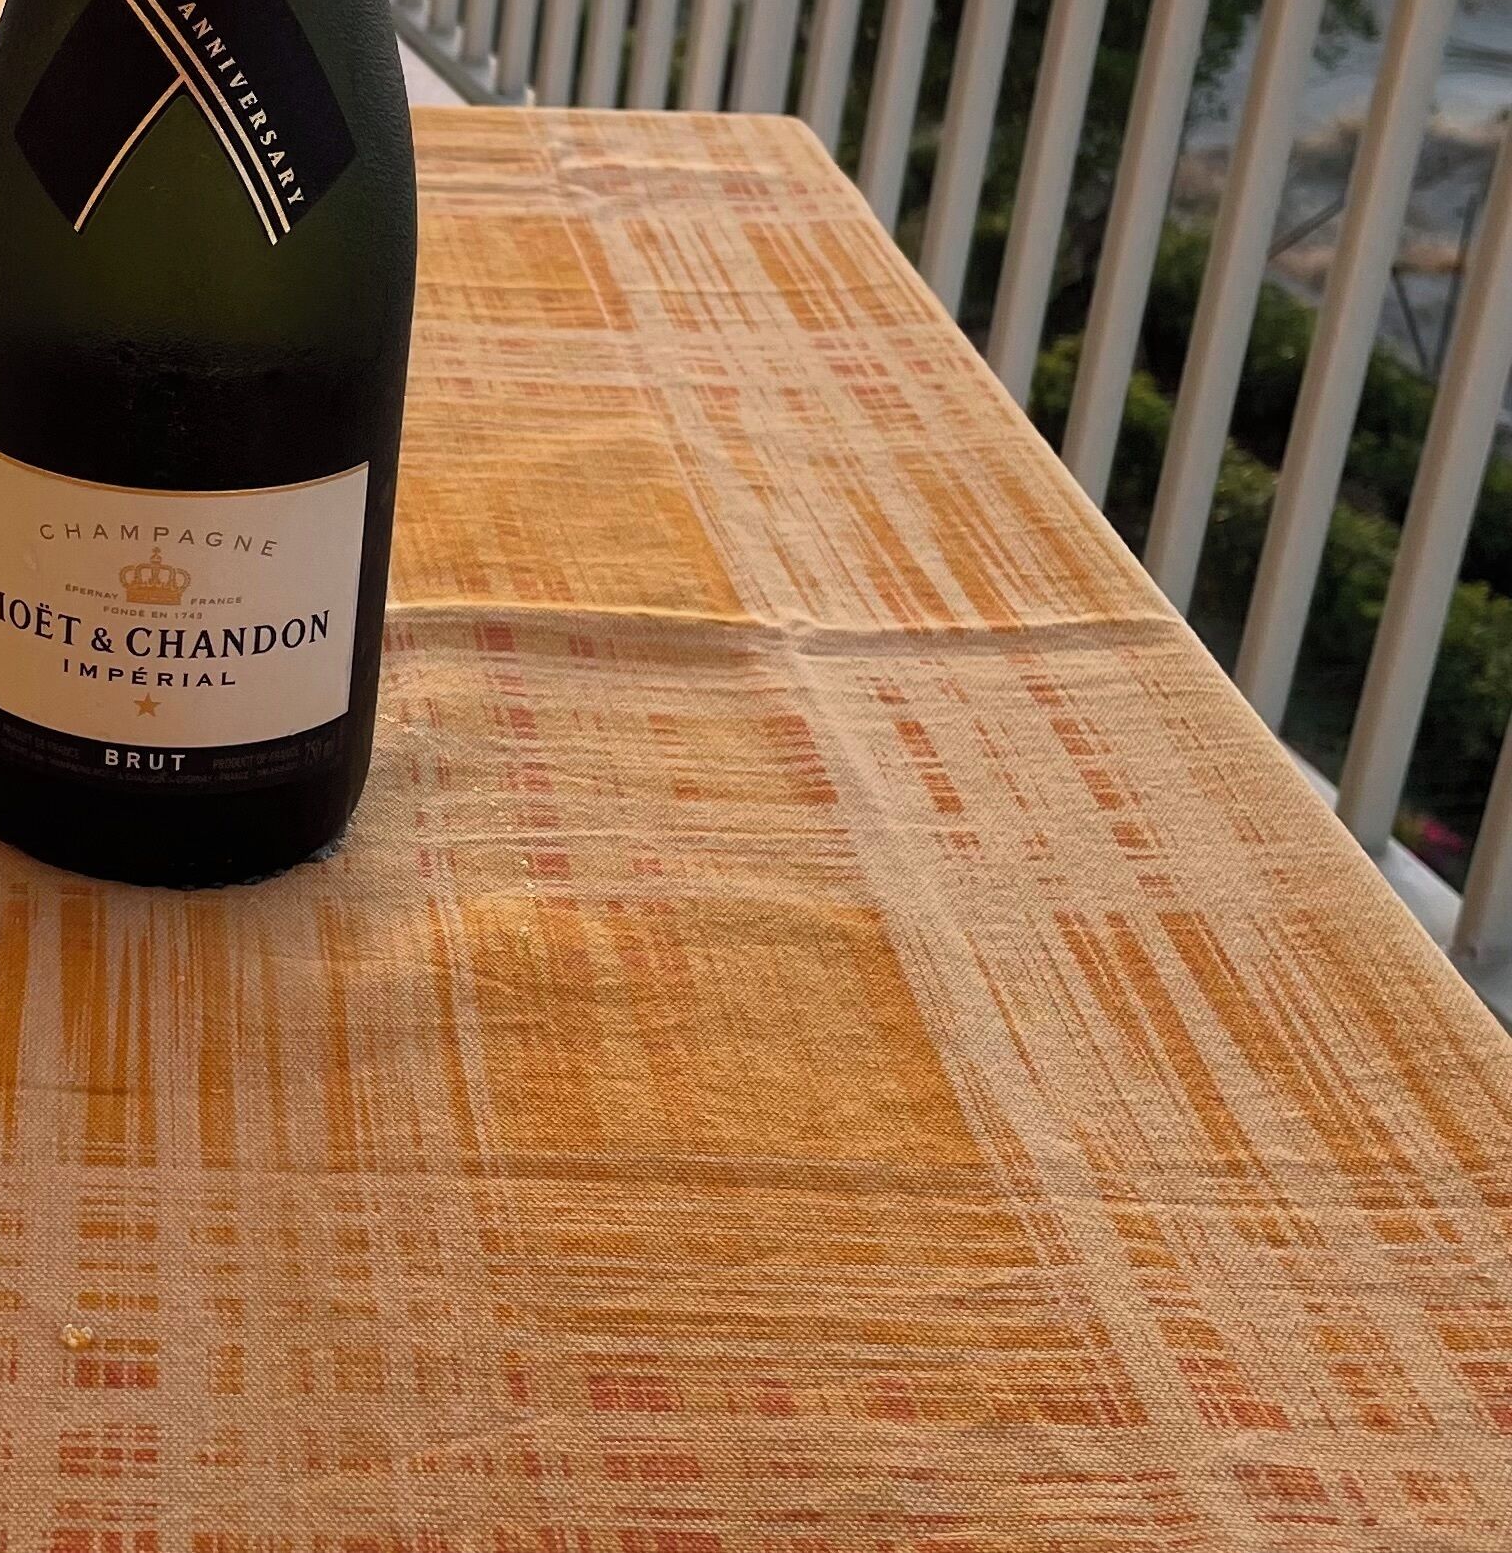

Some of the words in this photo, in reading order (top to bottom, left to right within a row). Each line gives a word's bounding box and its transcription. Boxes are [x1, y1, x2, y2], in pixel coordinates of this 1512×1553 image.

[177, 1, 305, 206] ANNIVERSARY
[39, 523, 279, 558] CHAMPAGNE
[151, 610, 168, 620] EN
[190, 596, 243, 606] FRANCE
[90, 626, 114, 654] &
[125, 609, 330, 660] CHANDON
[63, 658, 237, 688] IMPÉRIAL
[104, 747, 187, 772] BRUT
